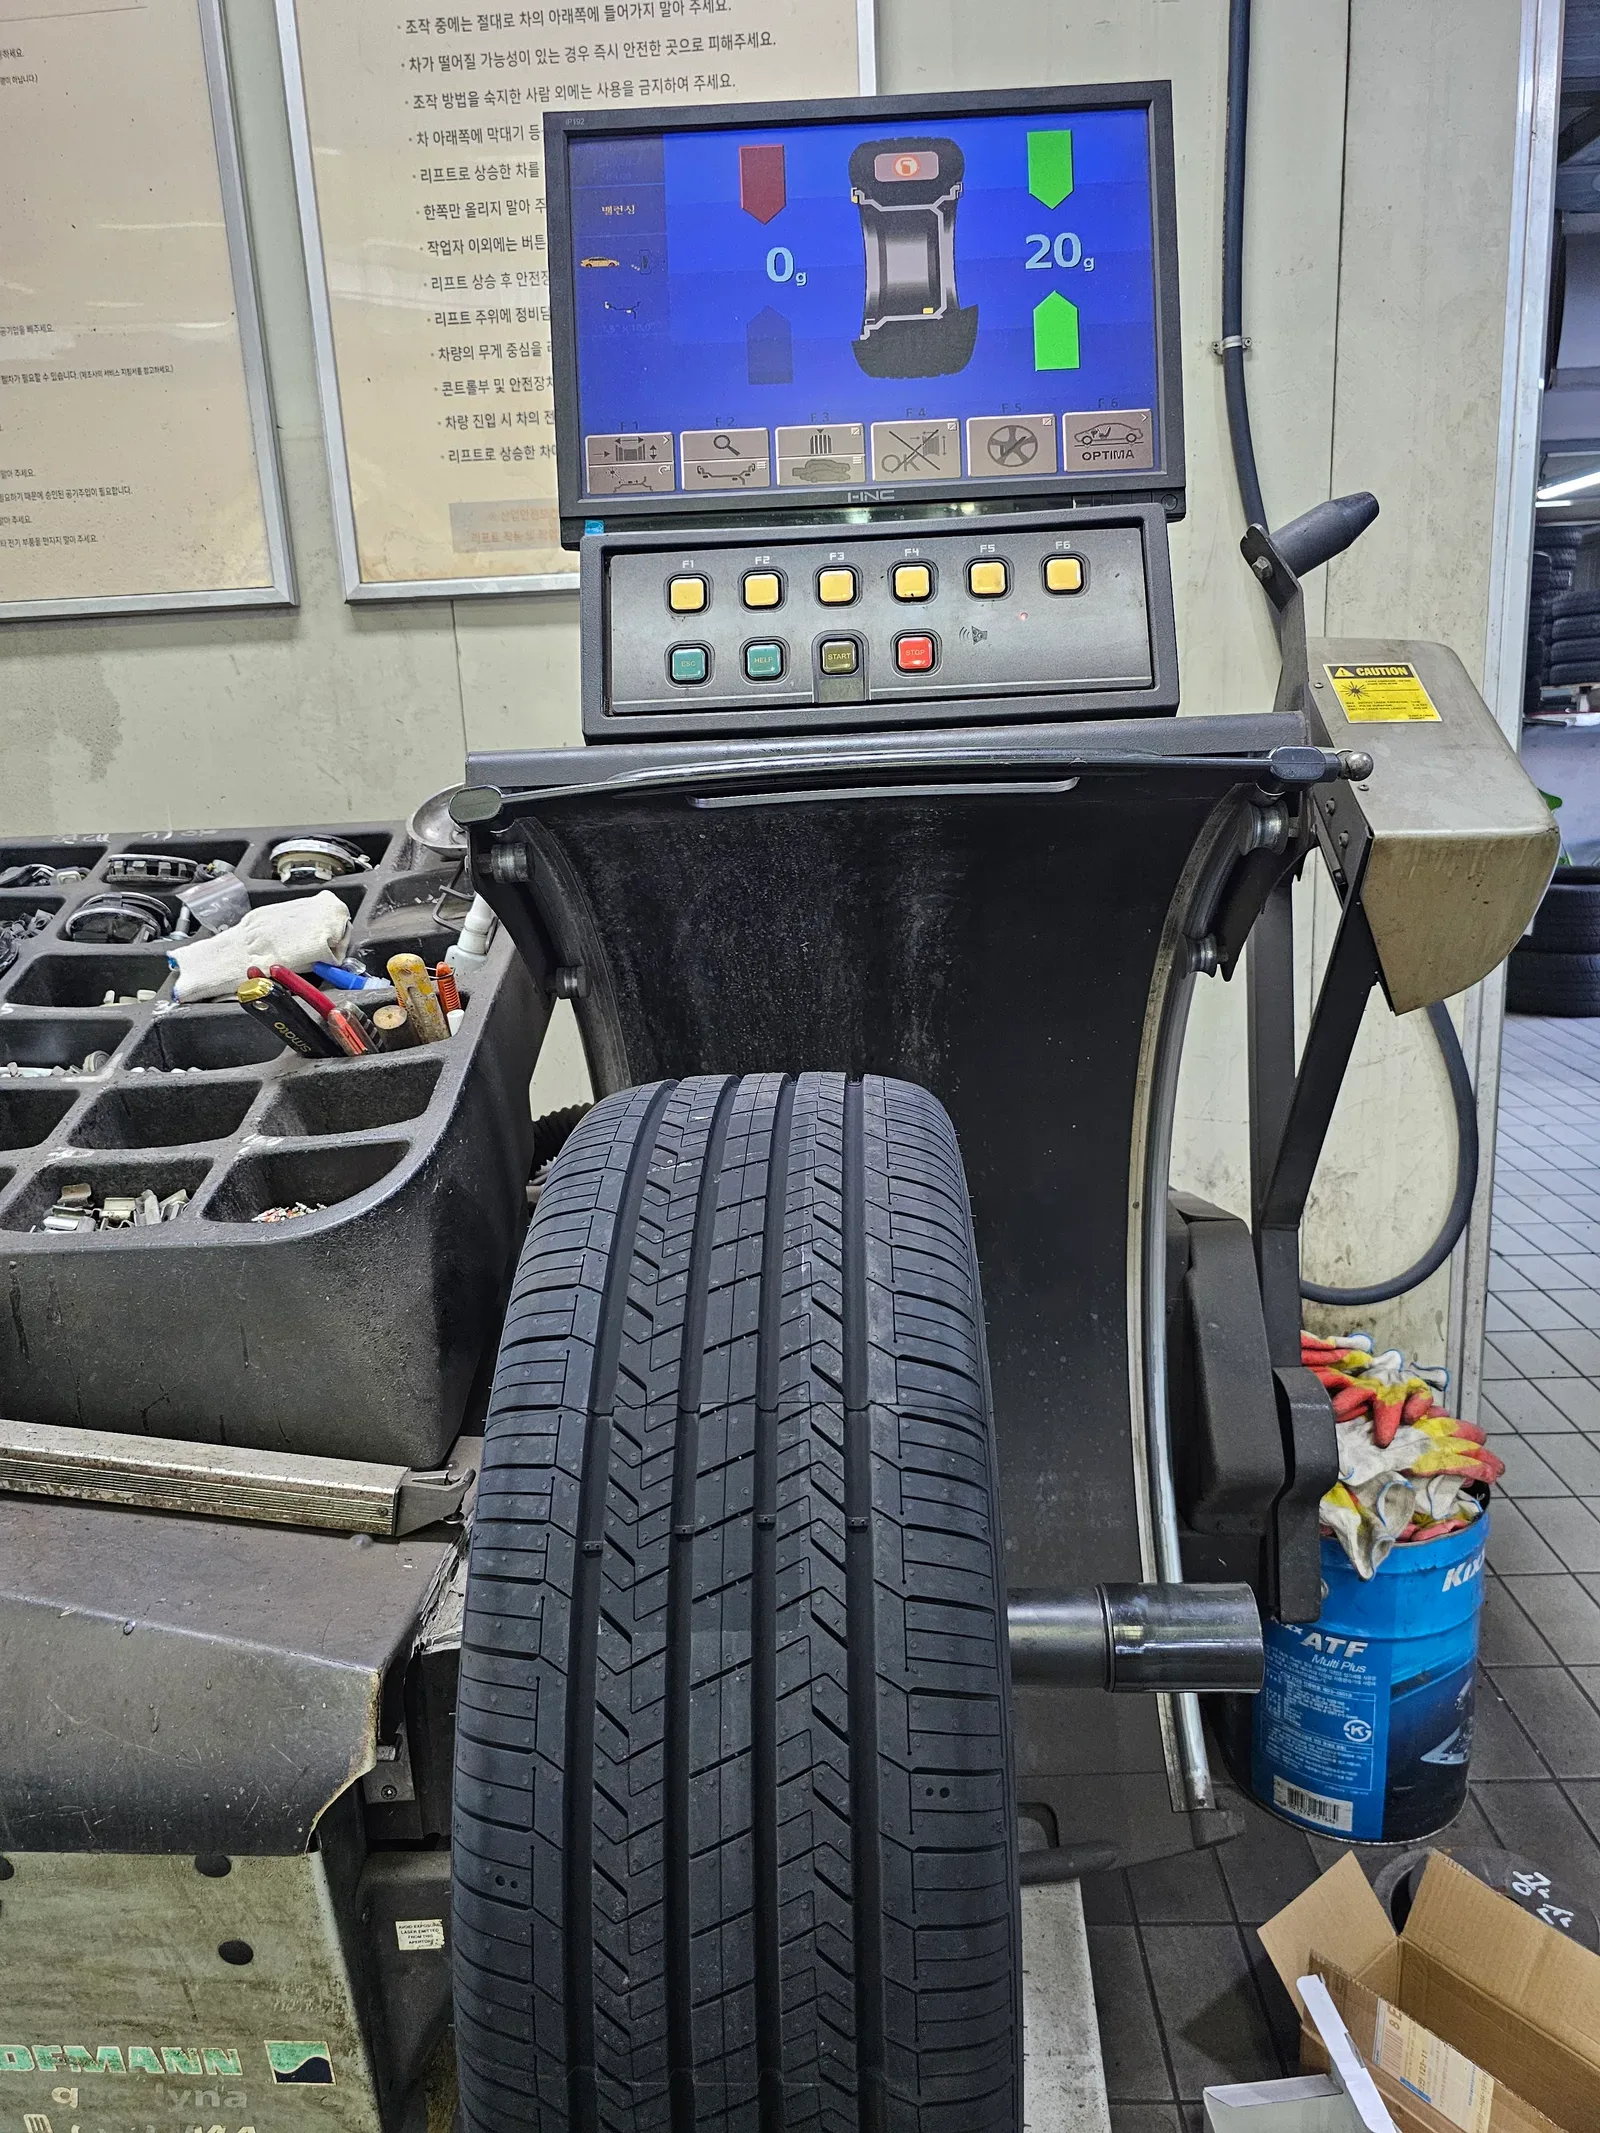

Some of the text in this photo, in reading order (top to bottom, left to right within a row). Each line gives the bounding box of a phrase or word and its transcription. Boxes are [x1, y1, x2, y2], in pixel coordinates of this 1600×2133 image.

[405, 18, 430, 35] 조작
[434, 16, 473, 34] 중에는
[477, 13, 516, 31] 절대로
[519, 10, 544, 28] 차의
[548, 6, 599, 26] 아래쪽에
[604, 3, 655, 22] 들어가지
[659, 1, 685, 18] 말아
[409, 31, 776, 73] 차가 떨어질 가능성이 있는 경우 즉시 안전한 곳으로 피해주세요.
[413, 73, 736, 110] 조작 방법을 숙지한 사람 외에는 사용을 금지하여 주세요.
[417, 131, 429, 147] 차
[433, 128, 483, 146] 아래쪽에
[487, 125, 524, 143] 막대기
[420, 161, 540, 184] 리프트로 상승한 차를
[424, 203, 460, 220] 한쪽만
[464, 200, 501, 218] 올리지
[506, 199, 531, 216] 말아
[427, 234, 546, 256] 작업자 이외에는 버튼
[431, 275, 468, 292] 리프트
[472, 273, 496, 290] 상승
[500, 272, 512, 288] 후
[435, 311, 472, 327] 리프트
[475, 308, 511, 325] 주위에
[438, 345, 474, 362] 차량의
[479, 343, 503, 360] 무게
[506, 341, 542, 358] 중심을
[442, 379, 490, 397] 콘트롤부
[494, 378, 505, 394] 및
[445, 415, 468, 430] 차량
[473, 413, 496, 429] 진입
[501, 412, 512, 427] 시
[516, 410, 540, 426] 차의
[448, 447, 496, 464] 리프트로
[500, 445, 535, 461] 상승한
[1082, 449, 1135, 462] OPTIMA
[904, 547, 920, 558] F4
[979, 543, 996, 554] F5
[1055, 540, 1071, 551] F6
[682, 560, 695, 569] F1
[755, 555, 771, 565] F2
[829, 551, 845, 562] F3
[754, 656, 773, 664] HELP
[827, 652, 851, 661] START
[905, 648, 926, 658] STOP
[1355, 667, 1409, 676] CAUTION
[1301, 1631, 1369, 1658] ATF
[1311, 1653, 1340, 1670] Multi
[1340, 1660, 1368, 1674] Plus
